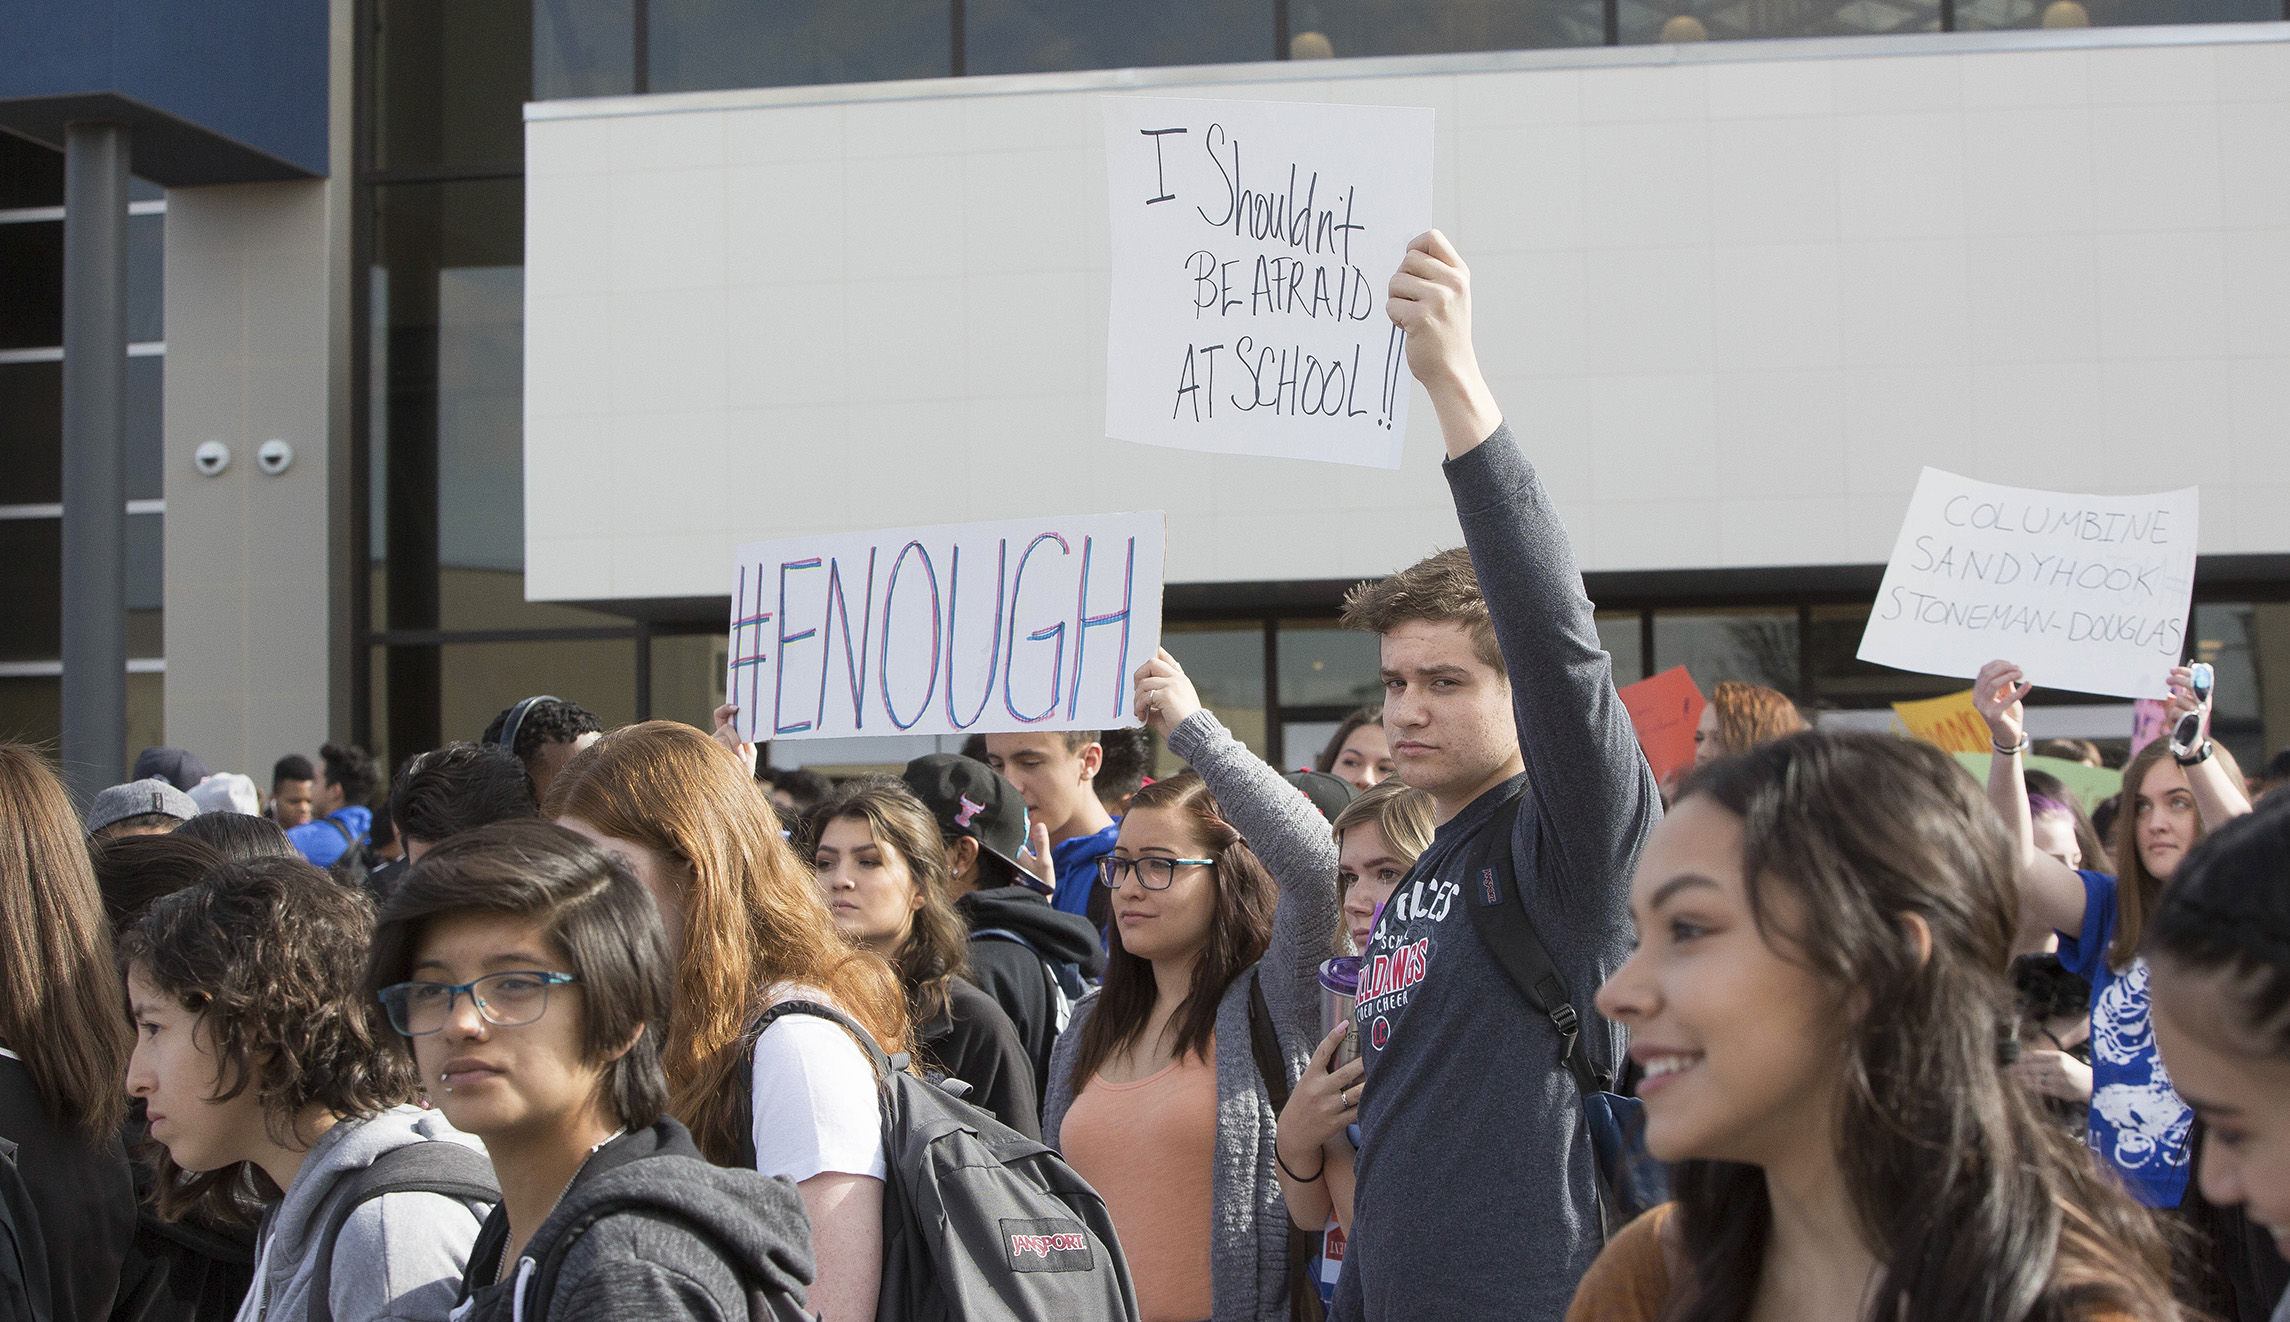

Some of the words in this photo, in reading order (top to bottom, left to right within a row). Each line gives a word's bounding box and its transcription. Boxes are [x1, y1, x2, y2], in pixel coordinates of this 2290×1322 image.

[1140, 127, 1188, 205] I
[1184, 250, 1243, 320] BE
[1251, 253, 1373, 322] AFRAID
[1173, 343, 1224, 422] AT
[1943, 495, 2170, 545] COLUMBINE
[729, 531, 1135, 742] #ENOUGH
[1881, 585, 2182, 656] STONEMAN-DOUGLAS
[1374, 1021, 1387, 1046] LC
[1376, 990, 1409, 1013] CHEER
[1010, 1232, 1088, 1259] JANSPORT
